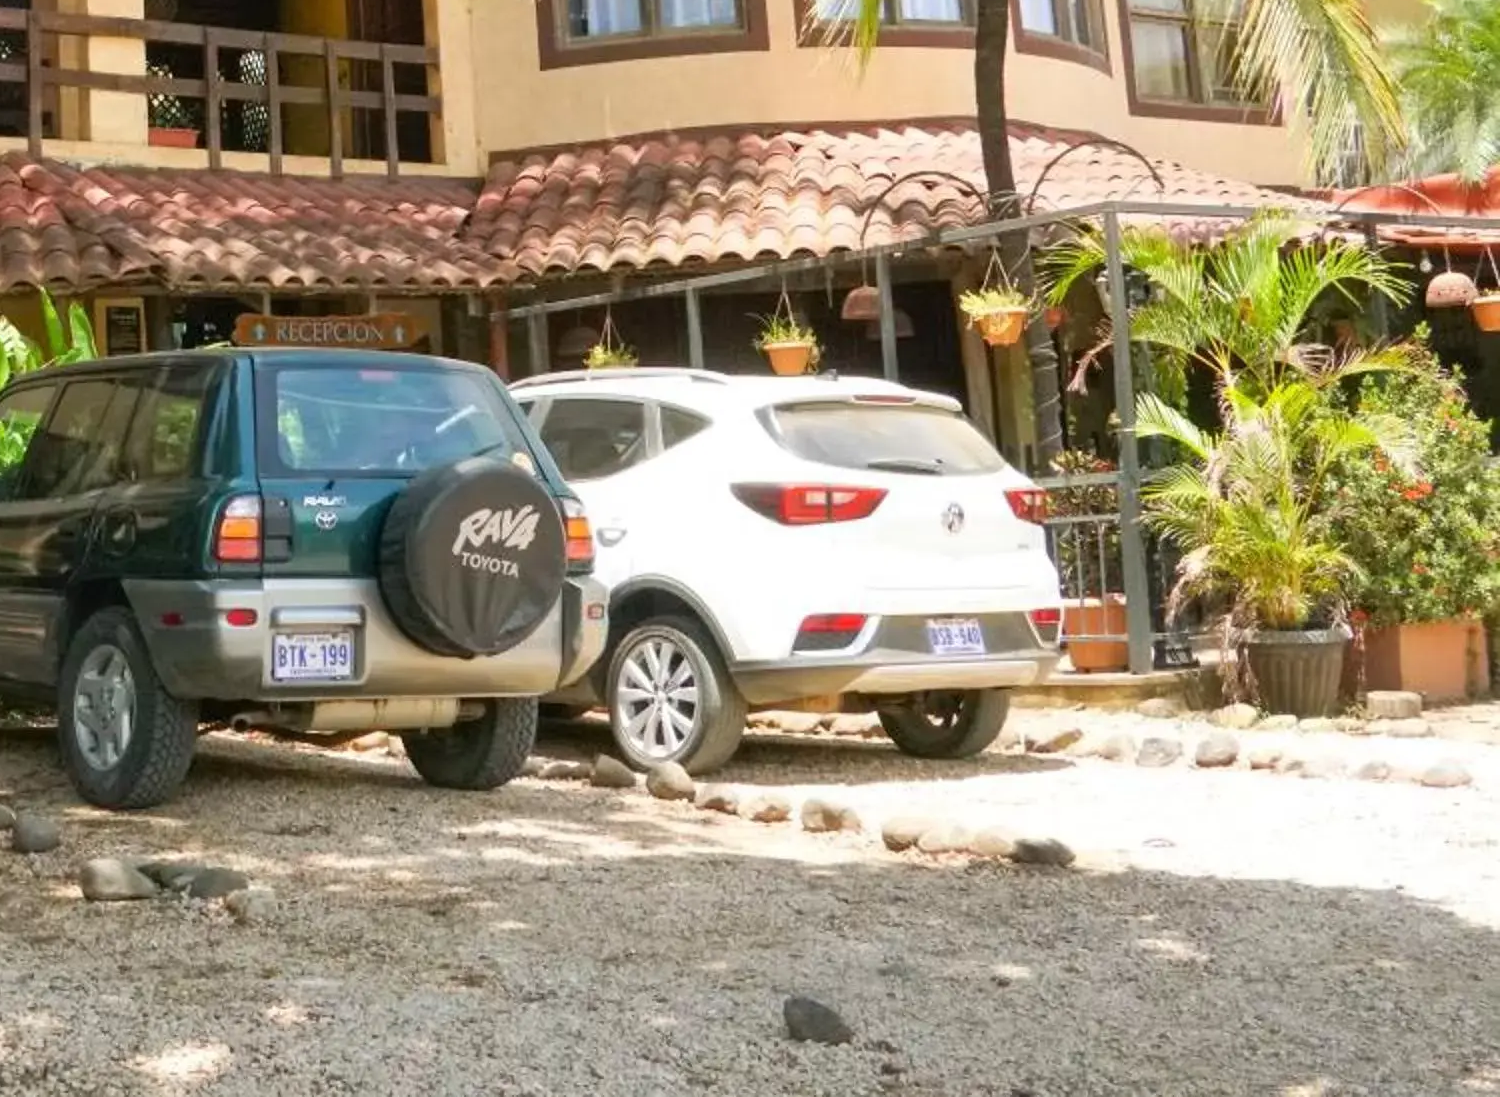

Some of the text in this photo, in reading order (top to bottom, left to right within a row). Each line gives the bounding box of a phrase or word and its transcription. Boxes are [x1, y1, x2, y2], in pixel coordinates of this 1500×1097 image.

[277, 320, 384, 343] RECEPCION
[461, 551, 519, 579] TOYOTA
[278, 643, 348, 668] BTK-199
